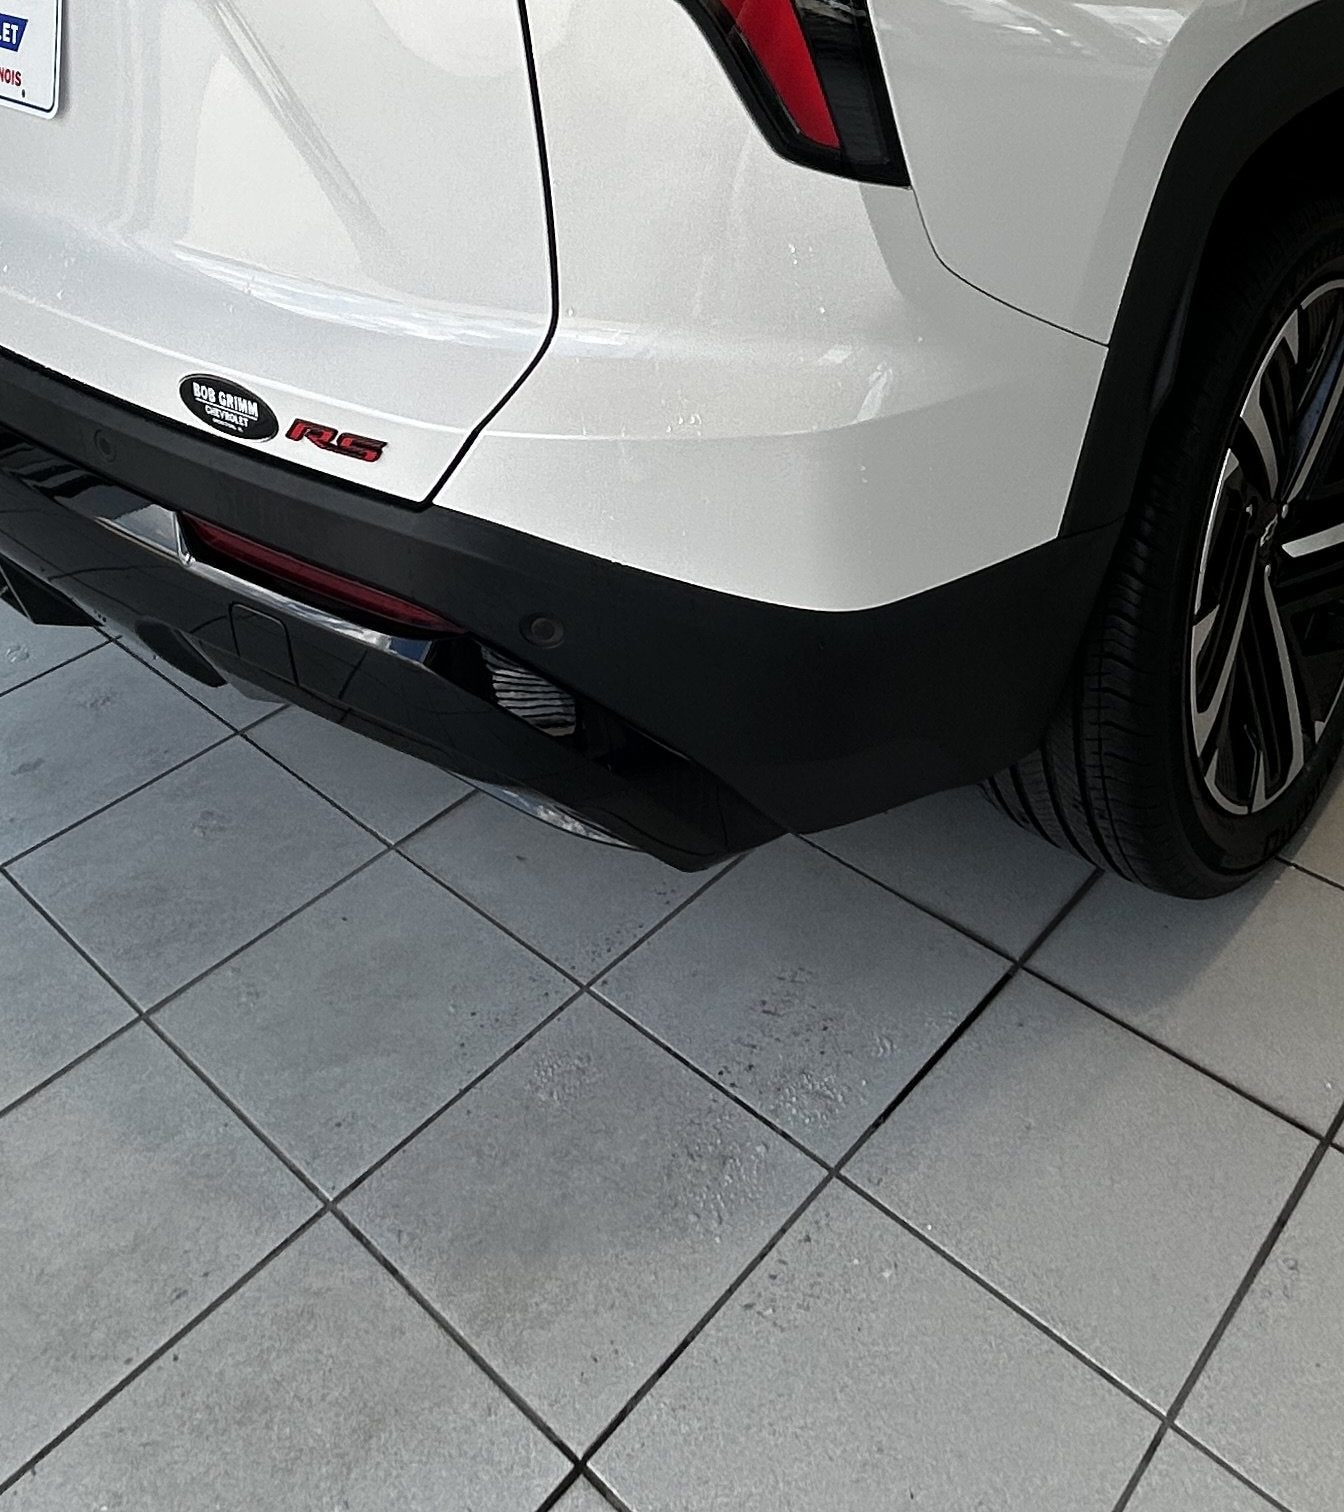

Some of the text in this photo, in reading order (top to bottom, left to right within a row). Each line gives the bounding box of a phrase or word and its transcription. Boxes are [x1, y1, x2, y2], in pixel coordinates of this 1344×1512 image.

[192, 381, 259, 418] BOB GRIMM
[204, 404, 249, 428] CHEVROLET
[285, 418, 388, 462] RS
